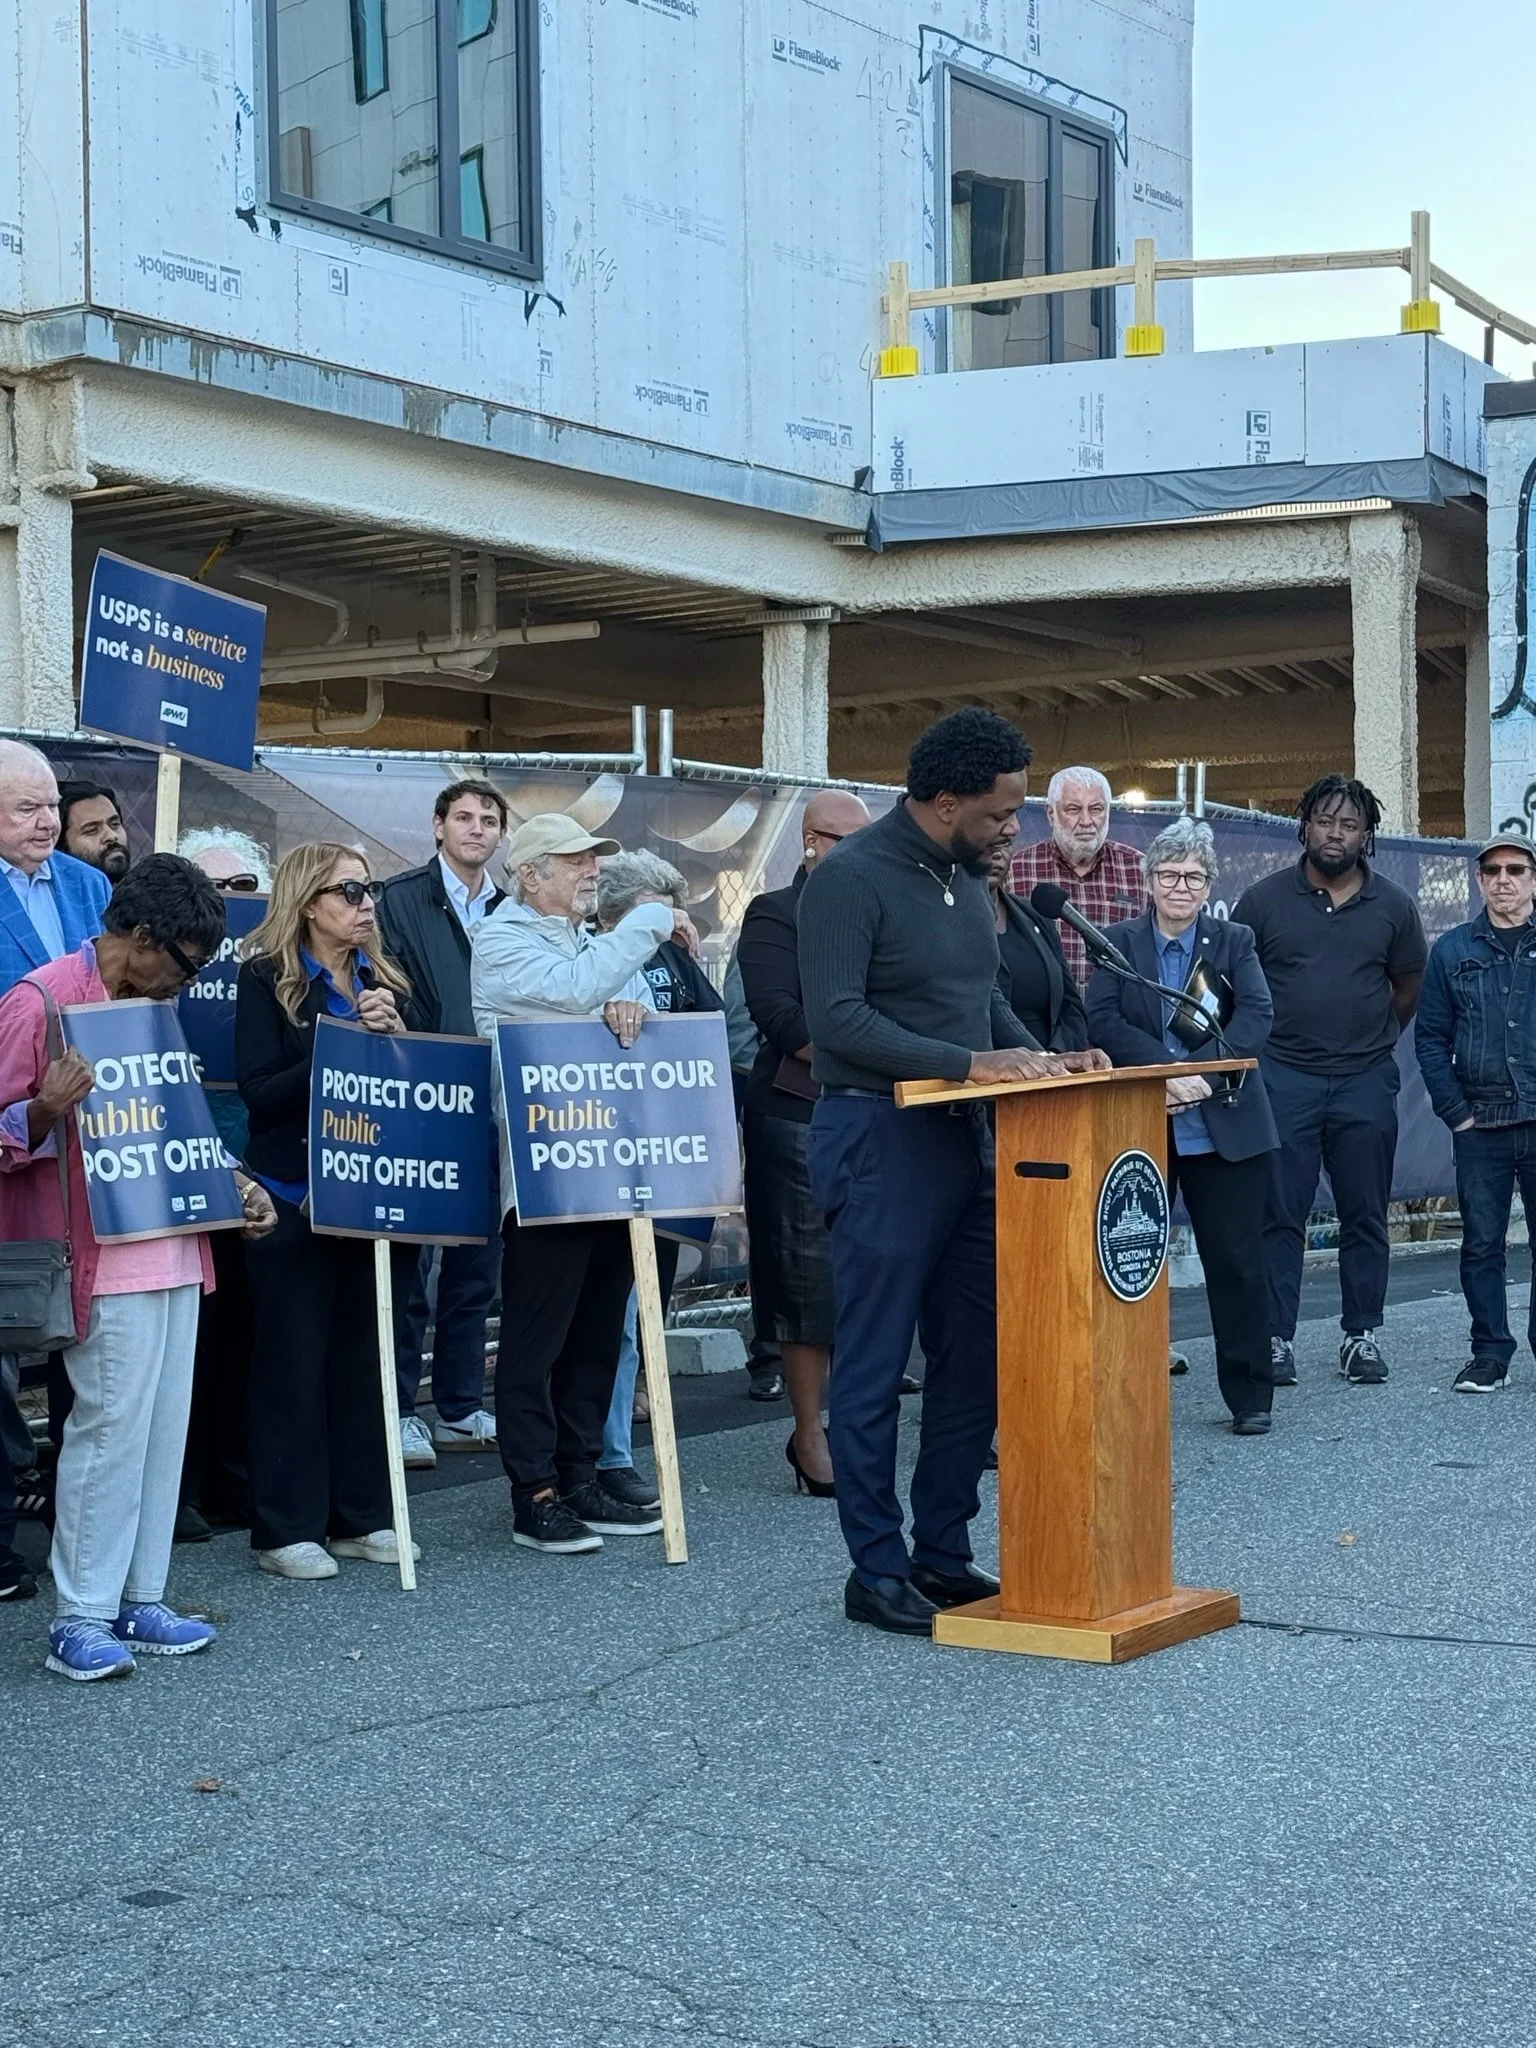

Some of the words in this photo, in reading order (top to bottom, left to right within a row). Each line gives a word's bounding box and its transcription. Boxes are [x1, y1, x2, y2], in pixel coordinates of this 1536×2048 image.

[774, 38, 785, 53] LP
[789, 40, 841, 73] FlameBlock
[1145, 183, 1184, 210] FlameBlock
[136, 254, 217, 293] FlameBlock
[223, 276, 239, 295] LP
[331, 268, 343, 291] LP
[634, 384, 692, 412] FlameBlock
[696, 398, 708, 414] LP
[785, 422, 837, 447] FlameBlock
[1253, 414, 1267, 434] LP
[99, 594, 151, 632] USPS
[154, 612, 169, 637] is
[172, 625, 184, 643] a
[185, 628, 247, 664] service
[96, 636, 129, 661] not
[131, 649, 143, 665] a
[147, 644, 225, 691] business
[189, 978, 224, 1000] not
[89, 1051, 189, 1094] OTECT
[521, 1062, 646, 1094] PROTECT
[651, 1059, 717, 1090] OUR
[322, 1067, 410, 1109] PROTECT
[414, 1082, 475, 1114] OUR
[321, 1108, 381, 1146] Public
[526, 1099, 618, 1134] Public
[322, 1149, 371, 1184] POST
[374, 1155, 460, 1190] OFFICE
[530, 1138, 609, 1171] POST
[613, 1135, 709, 1167] OFFICE
[1117, 1247, 1152, 1263] BOSTONIA
[1128, 1272, 1142, 1283] 1630
